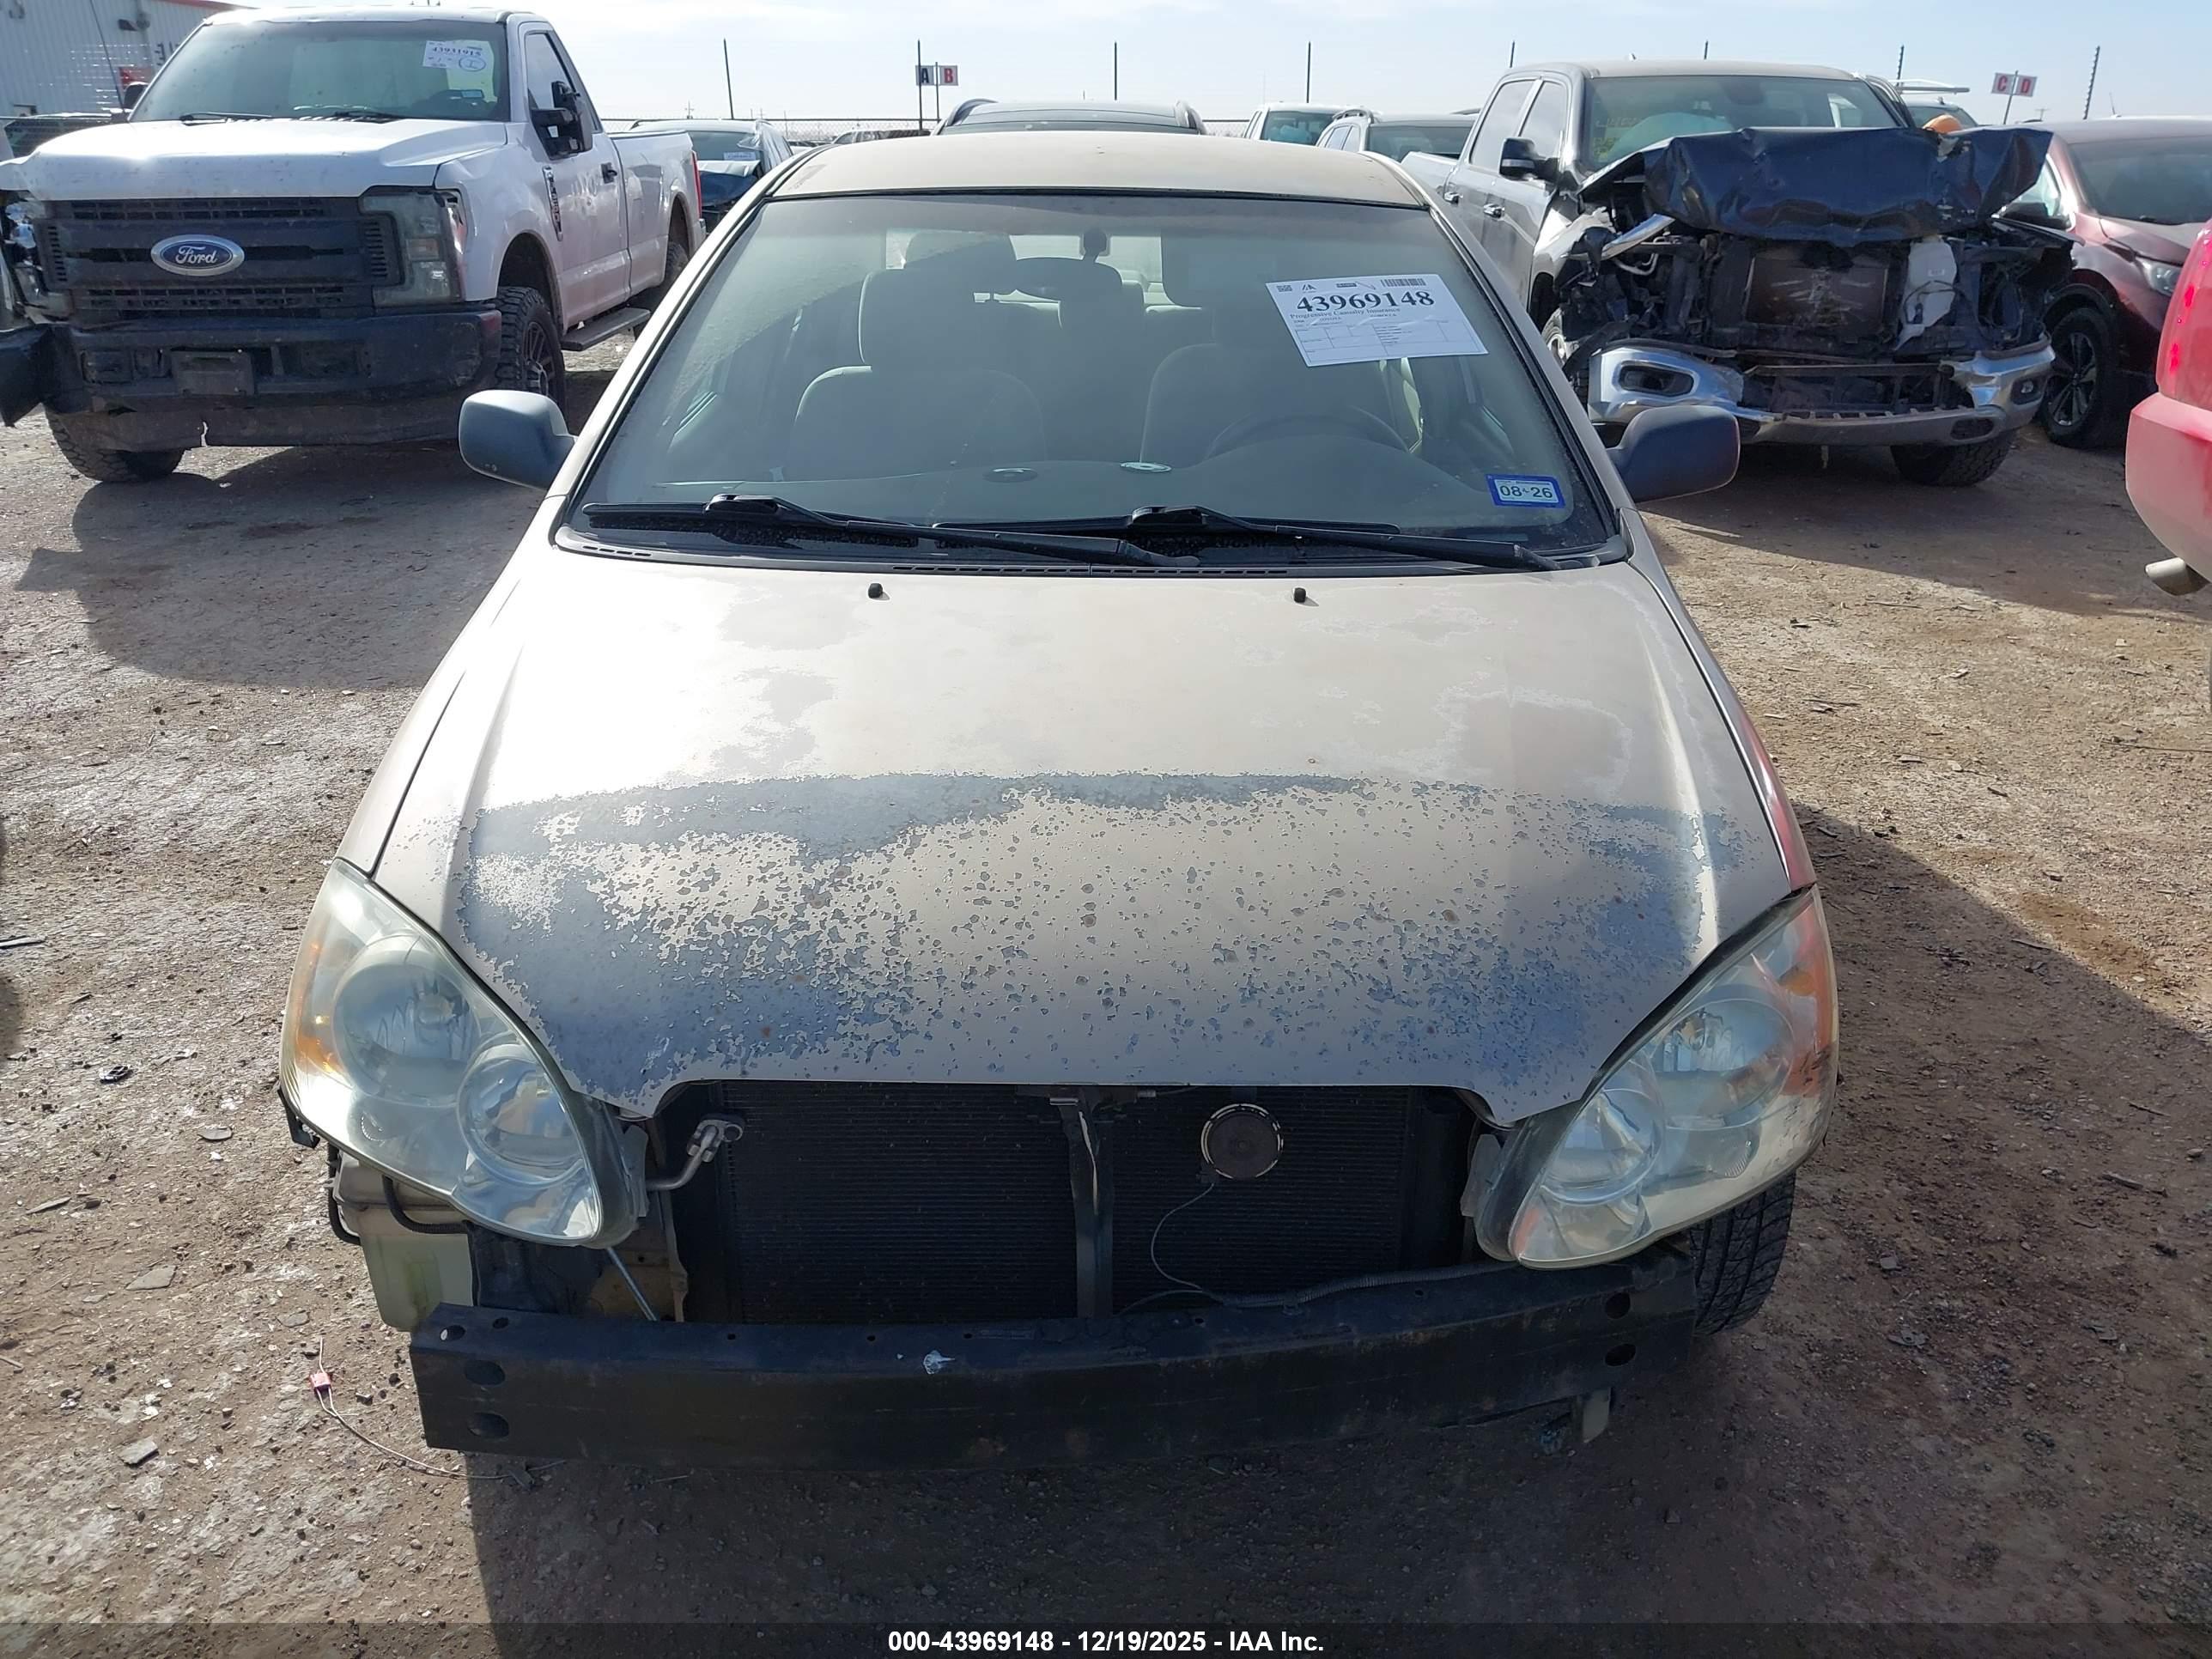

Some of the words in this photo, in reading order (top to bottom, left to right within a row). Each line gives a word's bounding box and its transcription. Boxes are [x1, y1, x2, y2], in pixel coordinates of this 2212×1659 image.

[921, 68, 929, 83] A
[944, 68, 954, 83] B
[1997, 76, 2008, 92] C
[2021, 79, 2031, 94] D
[175, 245, 218, 264] Ford
[1297, 291, 1434, 312] 43969148
[1499, 485, 1522, 496] 08
[1530, 486, 1553, 498] 26
